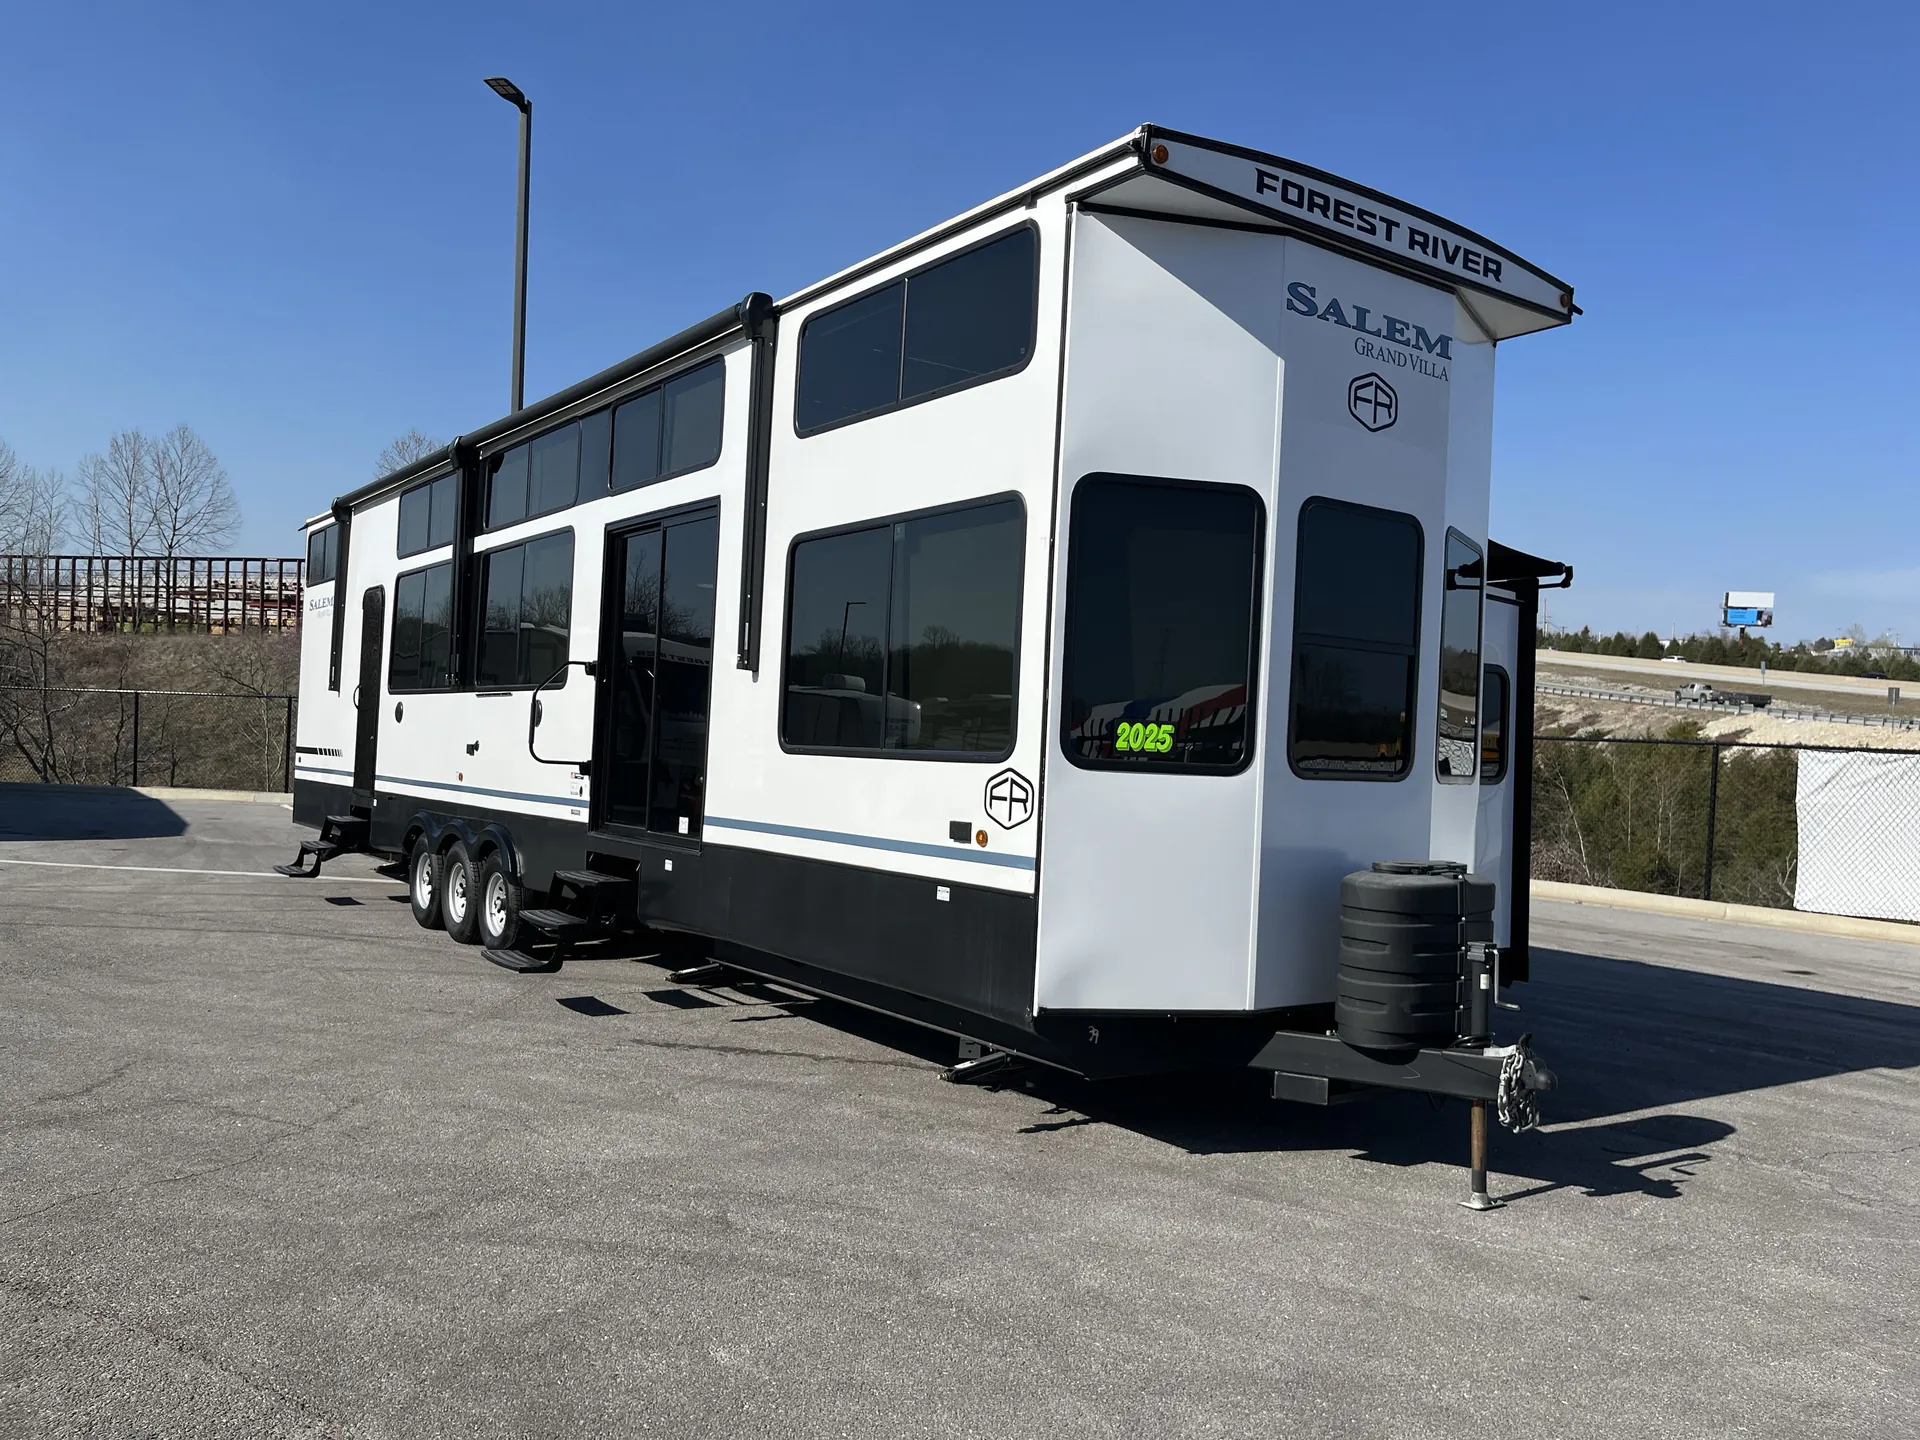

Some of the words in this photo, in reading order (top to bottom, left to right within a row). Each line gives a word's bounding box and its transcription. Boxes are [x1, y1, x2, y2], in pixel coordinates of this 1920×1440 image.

[1255, 168, 1400, 242] FOREST
[1407, 226, 1502, 283] RIVER
[1286, 281, 1452, 361] SALEM
[1354, 337, 1407, 367] GRAND
[1409, 353, 1449, 382] VILLA
[1353, 381, 1393, 424] FR
[1115, 722, 1175, 753] 2025
[989, 777, 1029, 822] FR
